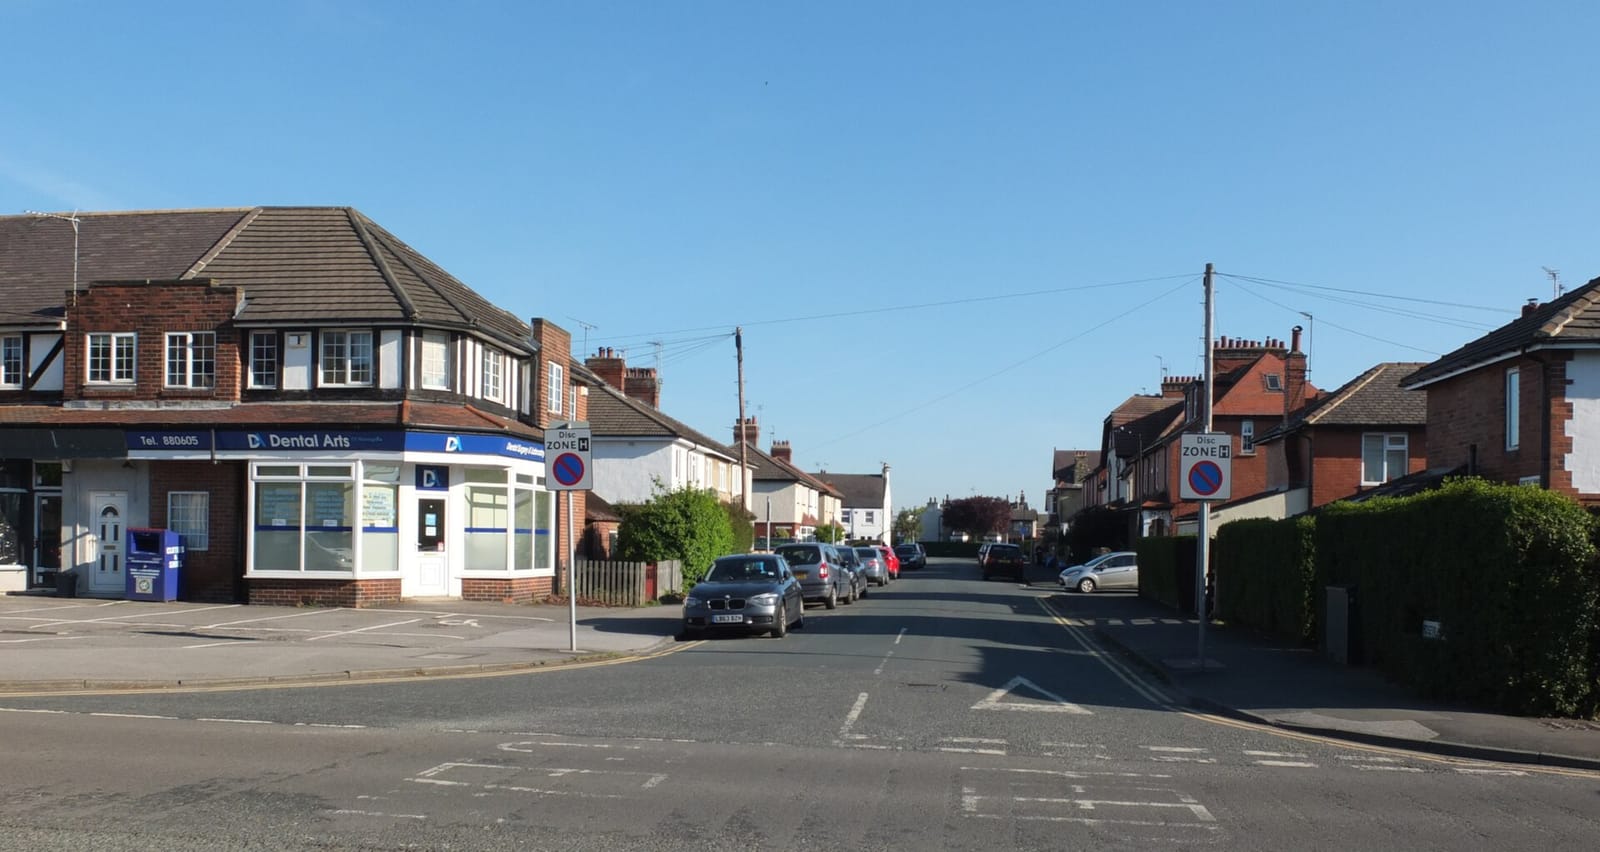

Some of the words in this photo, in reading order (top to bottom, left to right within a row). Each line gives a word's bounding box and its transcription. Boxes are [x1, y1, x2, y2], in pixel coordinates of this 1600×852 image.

[140, 436, 158, 446] Tel.
[163, 436, 199, 446] 880605
[269, 434, 319, 448] Dental
[323, 434, 351, 448] Arts
[547, 441, 577, 450] ZONE
[579, 439, 588, 450] H
[1197, 436, 1216, 444] Disc
[1183, 446, 1217, 457] ZONE
[1220, 445, 1229, 457] H
